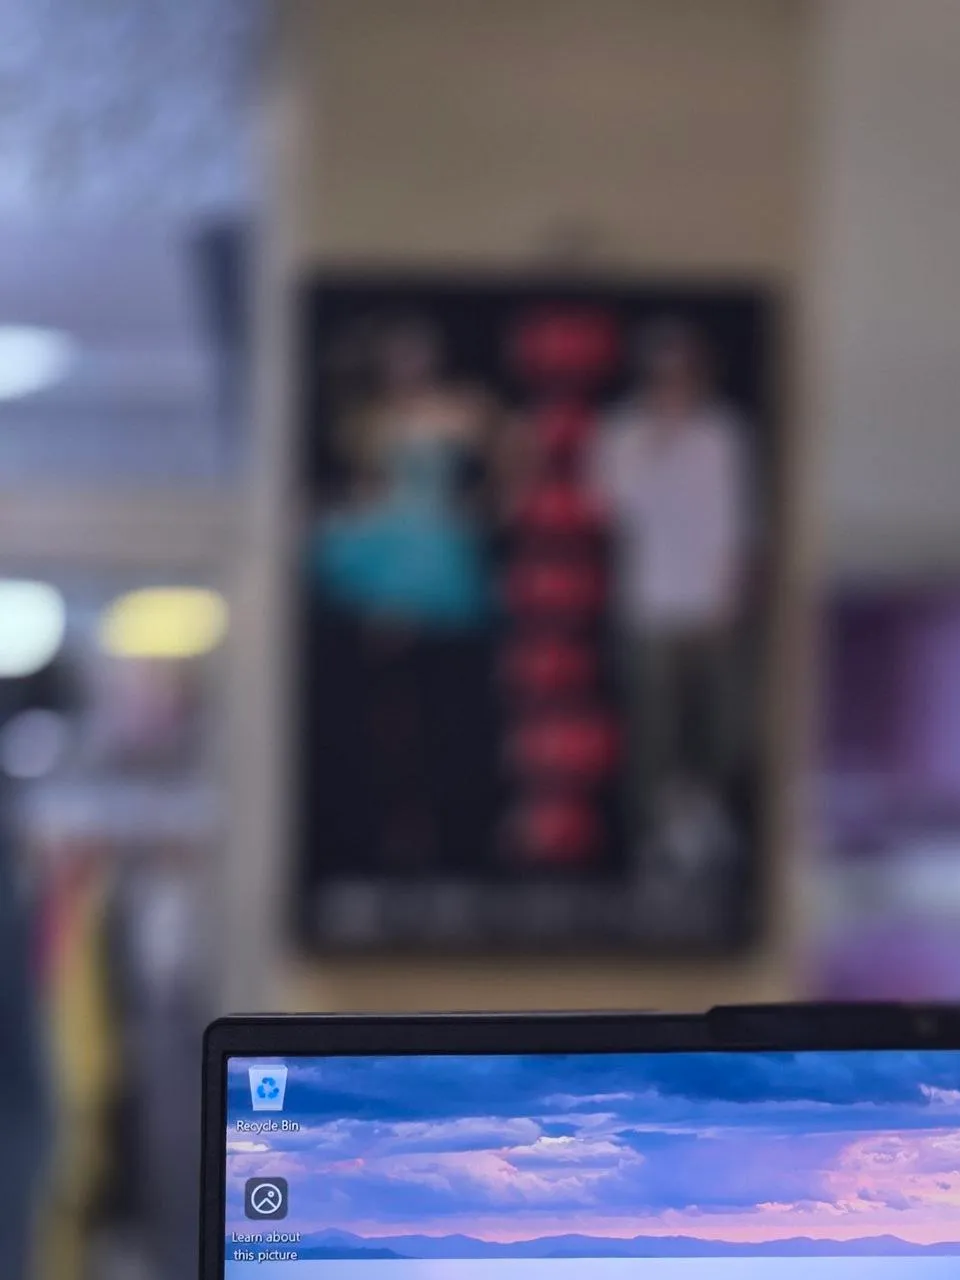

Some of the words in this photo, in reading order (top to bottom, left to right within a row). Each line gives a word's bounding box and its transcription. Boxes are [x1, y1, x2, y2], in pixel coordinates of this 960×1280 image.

[236, 1120, 279, 1133] Recycle
[282, 1120, 300, 1132] Bin
[232, 1232, 264, 1243] Learn
[266, 1232, 301, 1243] about
[234, 1249, 255, 1260] this
[258, 1249, 298, 1262] picture
